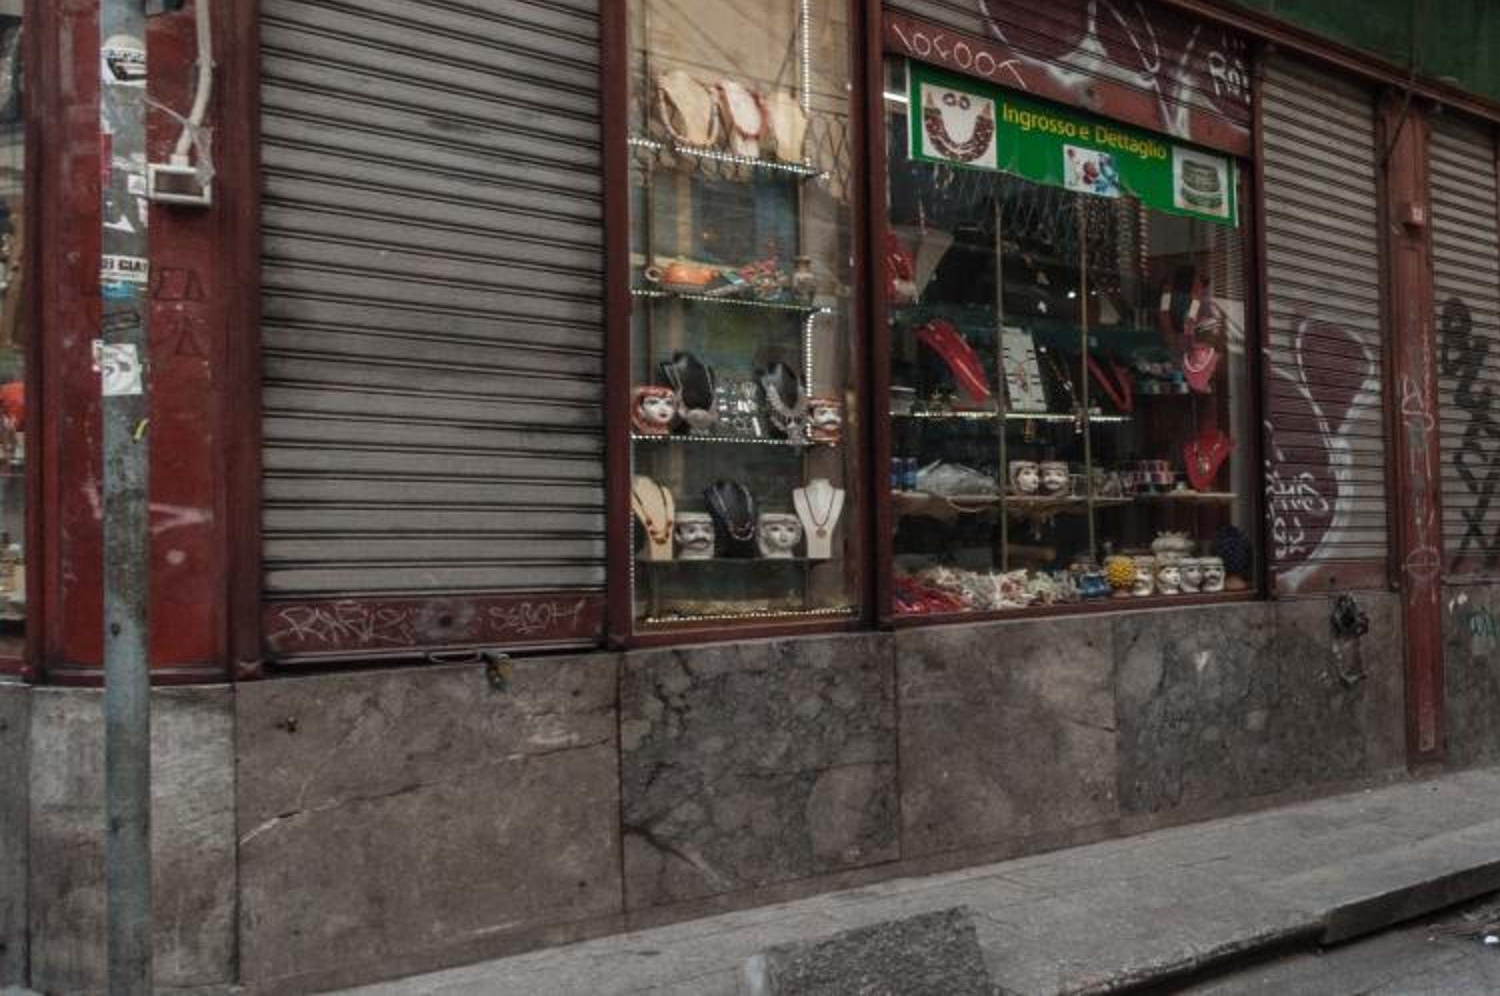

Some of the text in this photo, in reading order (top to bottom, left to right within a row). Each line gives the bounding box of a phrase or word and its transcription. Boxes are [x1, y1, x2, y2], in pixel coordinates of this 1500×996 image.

[1002, 102, 1168, 160] Ingrosso e Dettaglio
